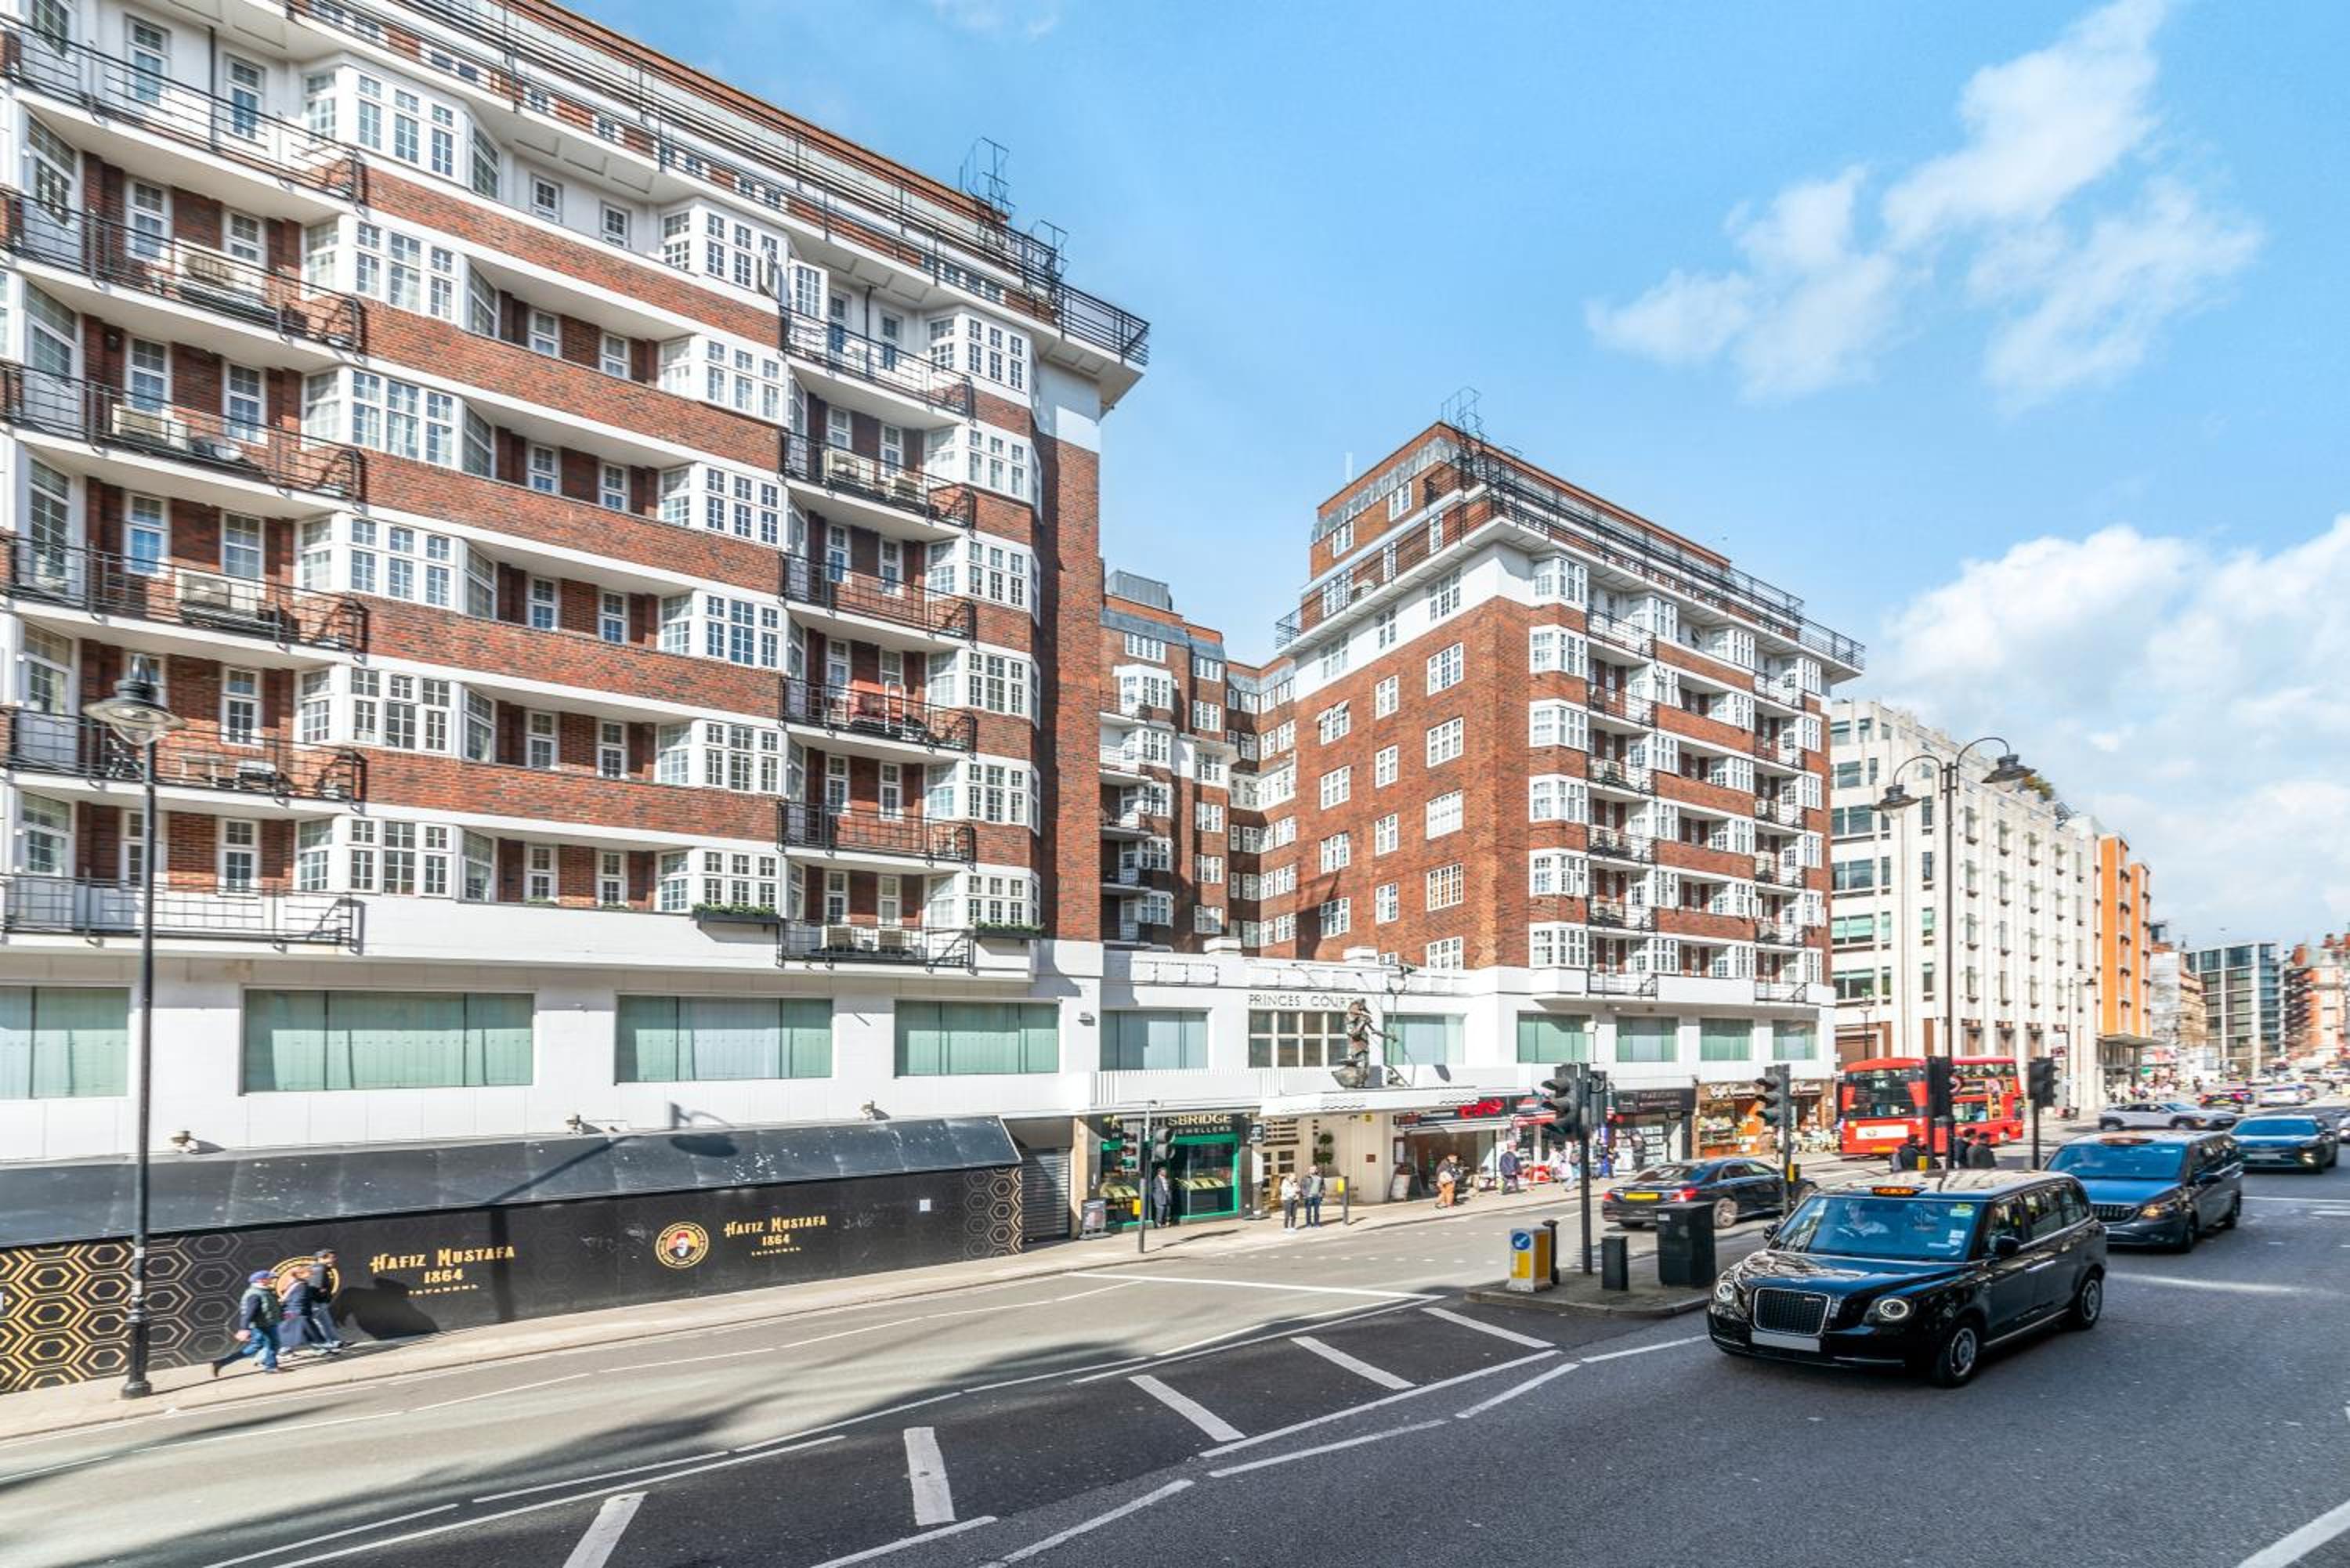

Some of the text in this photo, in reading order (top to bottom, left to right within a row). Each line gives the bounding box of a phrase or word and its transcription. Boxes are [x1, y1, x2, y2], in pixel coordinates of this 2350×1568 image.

[1248, 994, 1301, 1006] PRINCES
[1111, 1115, 1232, 1129] KTSBRIDGE
[1173, 1125, 1231, 1136] EWELLERS
[723, 1221, 765, 1237] HAFIZ
[772, 1215, 828, 1233] MUSTAFA
[762, 1234, 790, 1246] 1864
[369, 1247, 514, 1274] HAFIZ MUSTAFA
[424, 1268, 465, 1284] 1864
